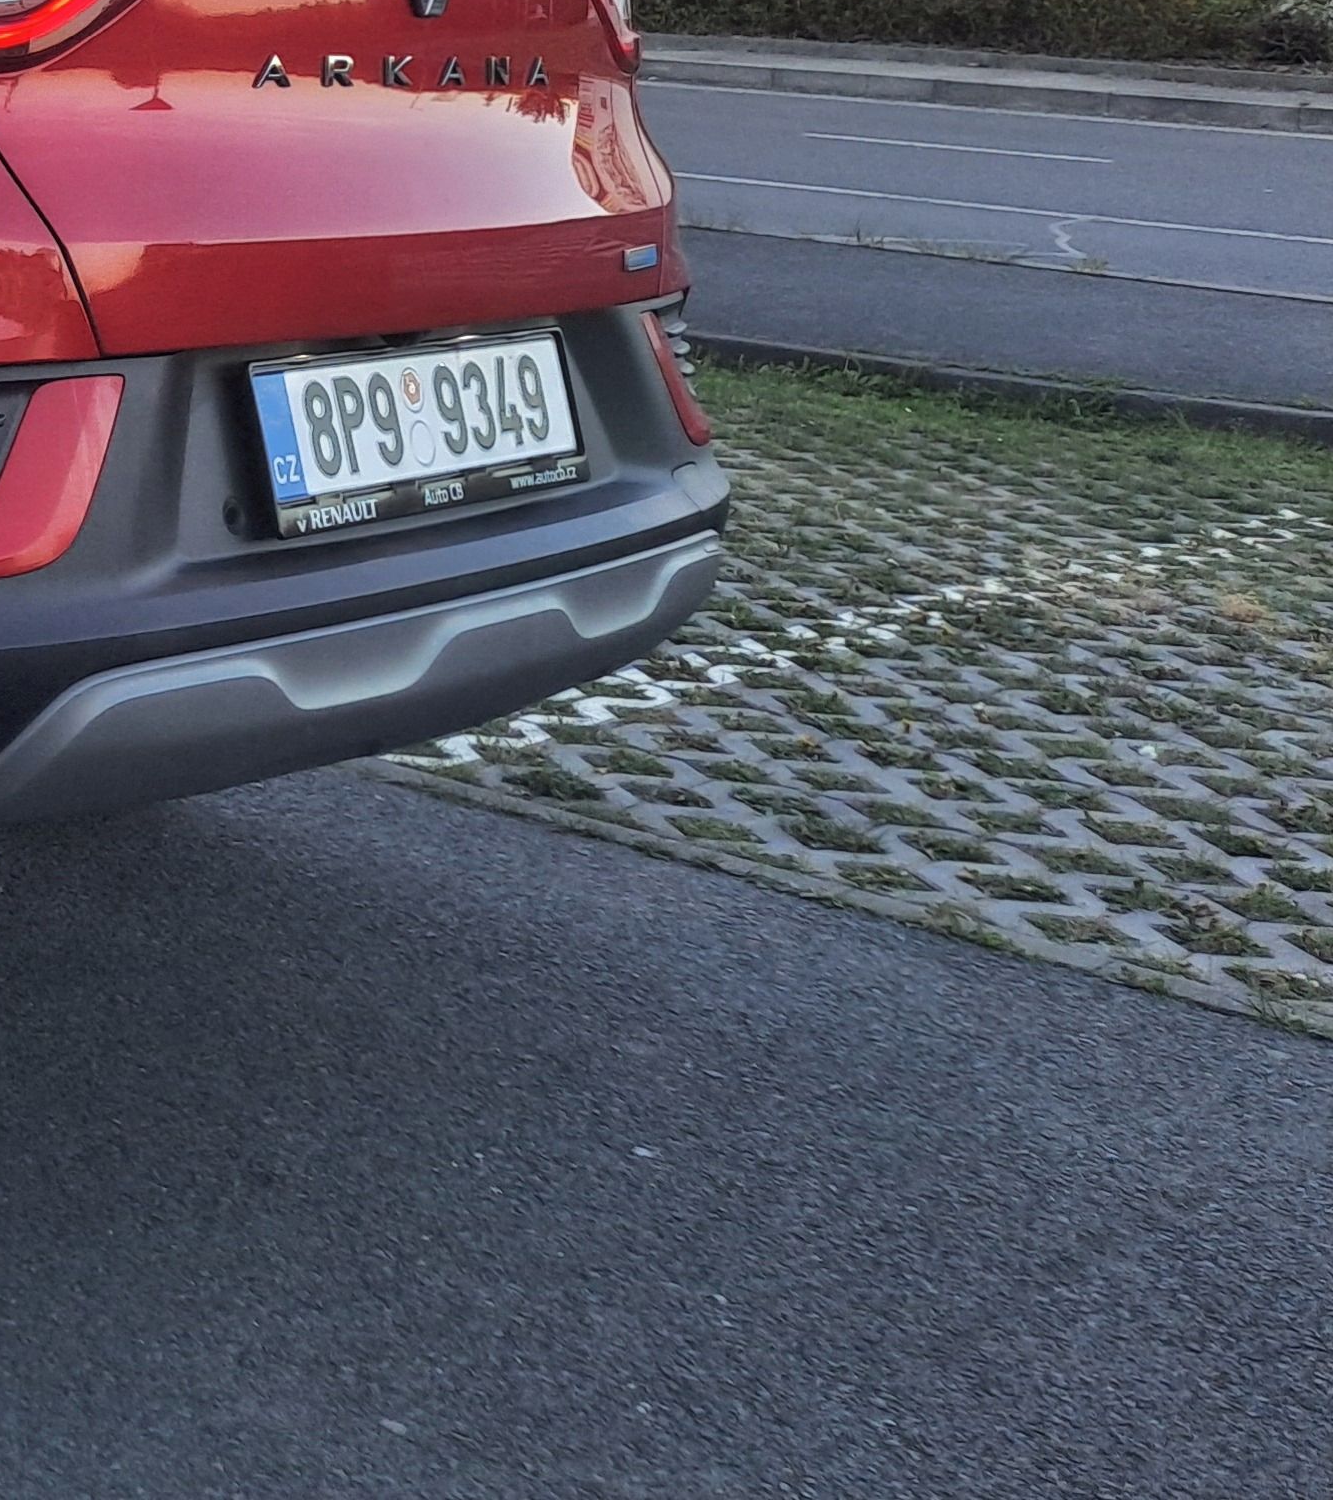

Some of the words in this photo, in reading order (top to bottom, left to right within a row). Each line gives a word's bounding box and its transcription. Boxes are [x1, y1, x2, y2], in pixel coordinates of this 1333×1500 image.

[252, 53, 550, 88] ARKANA
[302, 371, 405, 478] 8P9
[432, 354, 550, 455] 9349
[273, 455, 301, 486] CZ
[424, 487, 449, 506] Auto
[450, 482, 464, 500] CB
[309, 499, 379, 530] RENAULT
